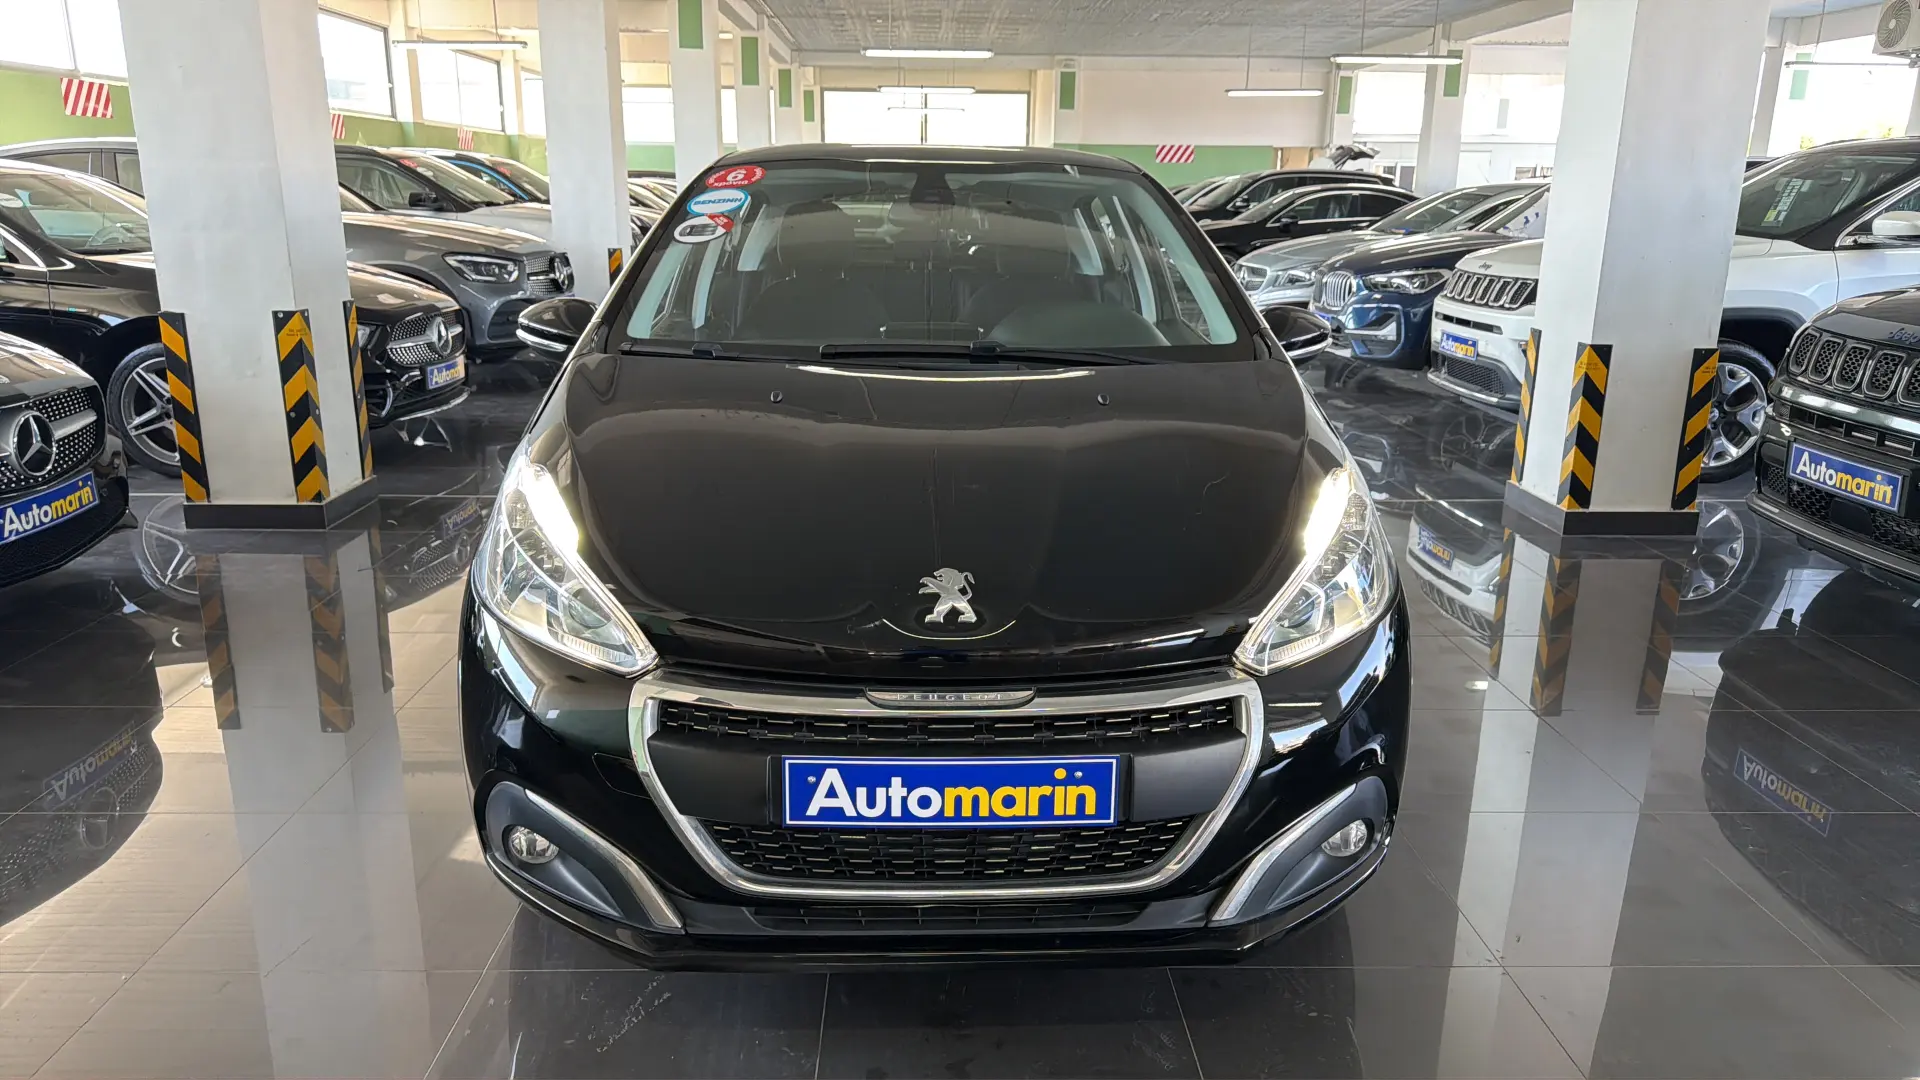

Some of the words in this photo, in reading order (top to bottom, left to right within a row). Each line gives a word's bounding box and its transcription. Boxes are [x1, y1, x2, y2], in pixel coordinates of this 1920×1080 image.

[726, 168, 747, 182] 6
[1440, 333, 1475, 357] Automarin
[1795, 451, 1893, 505] Automarin
[3, 481, 94, 538] Automarin
[805, 767, 1096, 818] Automarin
